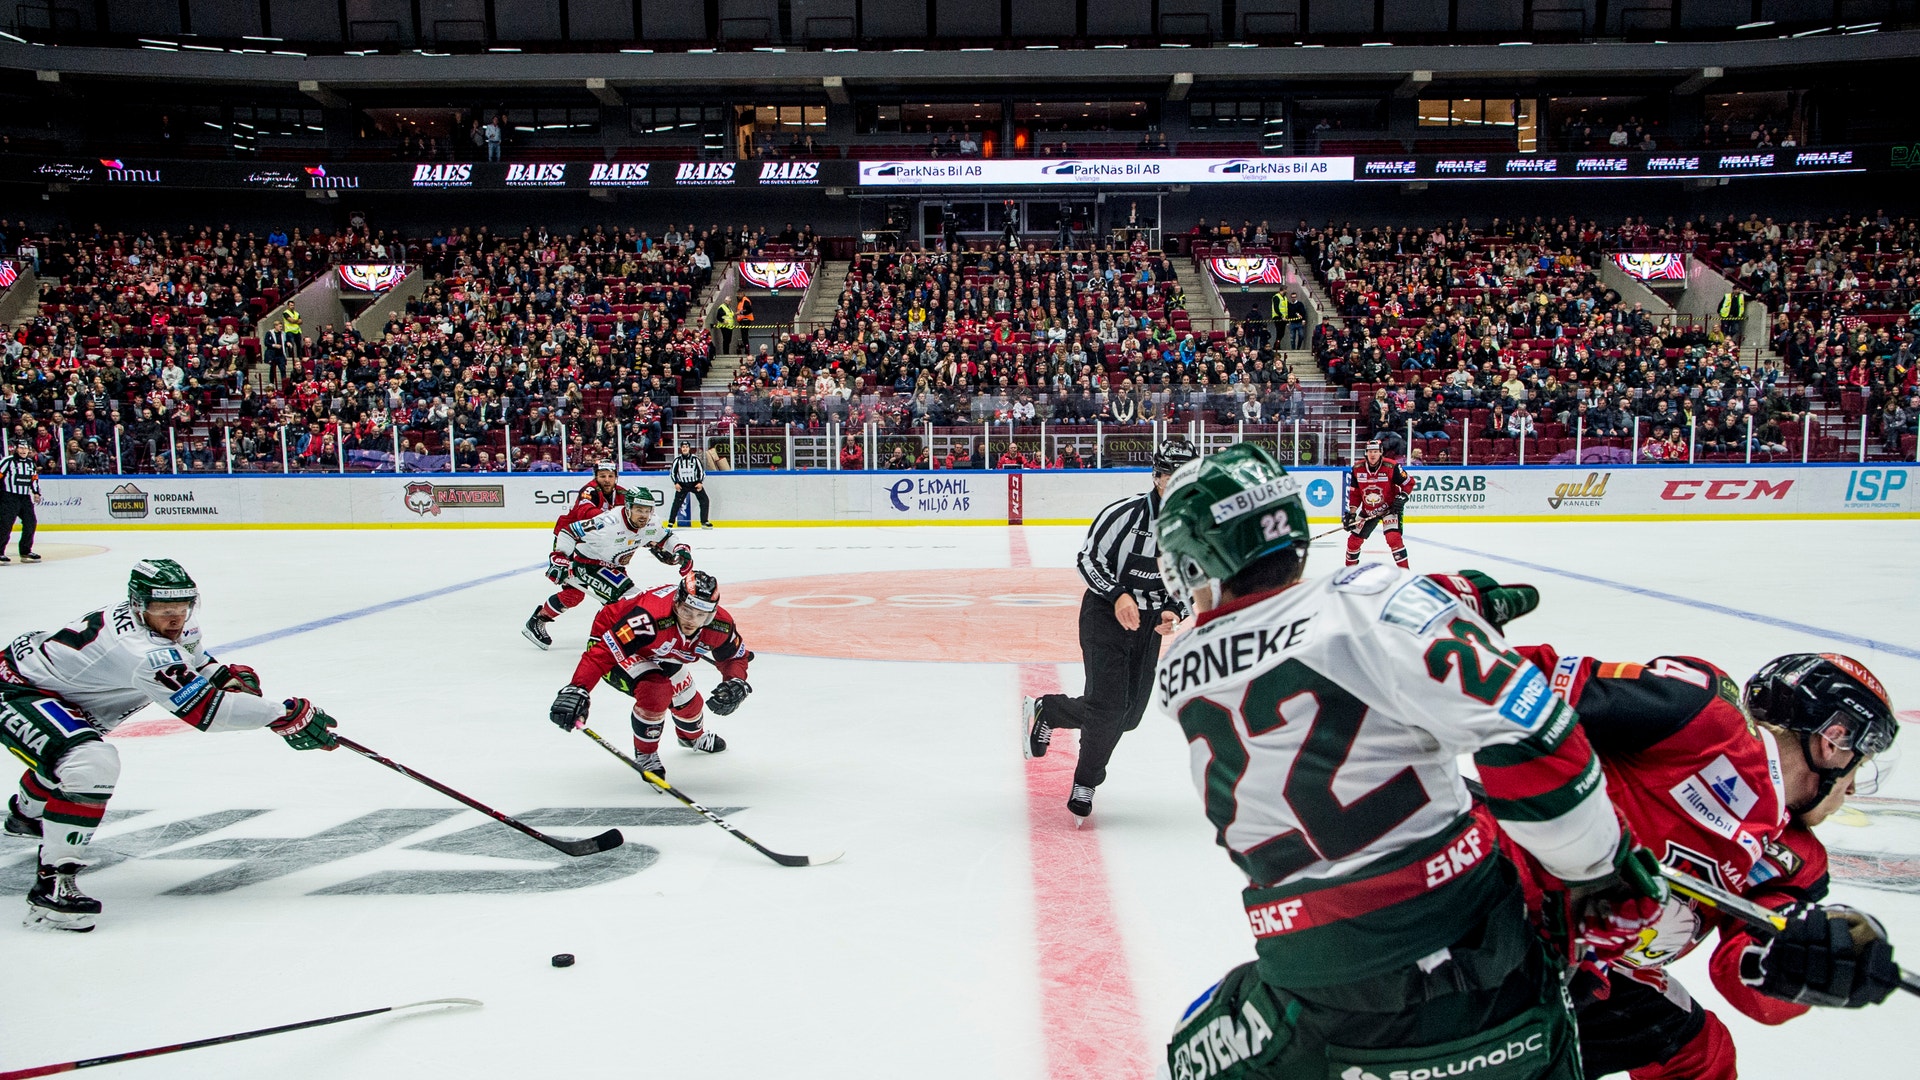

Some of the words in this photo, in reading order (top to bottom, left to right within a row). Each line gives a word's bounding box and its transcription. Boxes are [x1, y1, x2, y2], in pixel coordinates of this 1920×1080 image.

[108, 168, 161, 182] nmu
[412, 164, 472, 180] BAES
[506, 164, 566, 180] BAES
[589, 164, 650, 180] BAES
[675, 163, 736, 179] BAES
[759, 162, 819, 178] BAES
[896, 165, 946, 177] ParkNäs
[948, 166, 963, 176] Bil
[965, 165, 982, 176] AB
[1074, 164, 1123, 175] ParkNäs
[1126, 164, 1141, 174] Bil
[1143, 163, 1161, 174] AB
[1241, 162, 1291, 174] ParkNäs
[1293, 163, 1308, 173] Bil
[1310, 162, 1327, 173] AB
[311, 175, 360, 188] nmu
[714, 440, 781, 453] GRÖNSAKS
[1109, 439, 1153, 451] GRÖNS
[1255, 438, 1311, 450] RÖNSAKS
[734, 453, 773, 465] HUSET
[918, 478, 970, 495] EKDAHL
[1555, 472, 1612, 499] guld
[1660, 479, 1795, 500] CCM
[1845, 469, 1908, 501] ISP
[153, 491, 195, 502] NORDANÅ
[437, 488, 500, 503] NÄTVERK
[918, 495, 949, 513] MILJÖ
[953, 496, 970, 511] AB
[1409, 494, 1486, 502] NBROTTSSKYDD
[112, 501, 145, 510] GRUS.NU
[154, 506, 218, 515] GRUSTERMINAL
[1260, 508, 1292, 542] 22
[580, 573, 613, 597] STENA
[626, 612, 656, 637] 67
[1159, 617, 1312, 708] SERNEKE
[1423, 617, 1523, 706] 22
[154, 663, 198, 692] 12
[1843, 697, 1875, 719] CCM
[0, 702, 51, 757] TENA
[1178, 657, 1430, 887] 22
[1682, 783, 1733, 832] Tillmobil
[689, 802, 737, 831] CCM
[1426, 827, 1485, 889] SKF
[1720, 860, 1747, 894] MAL
[1250, 899, 1303, 936] SKF
[1188, 1000, 1274, 1080] STENA
